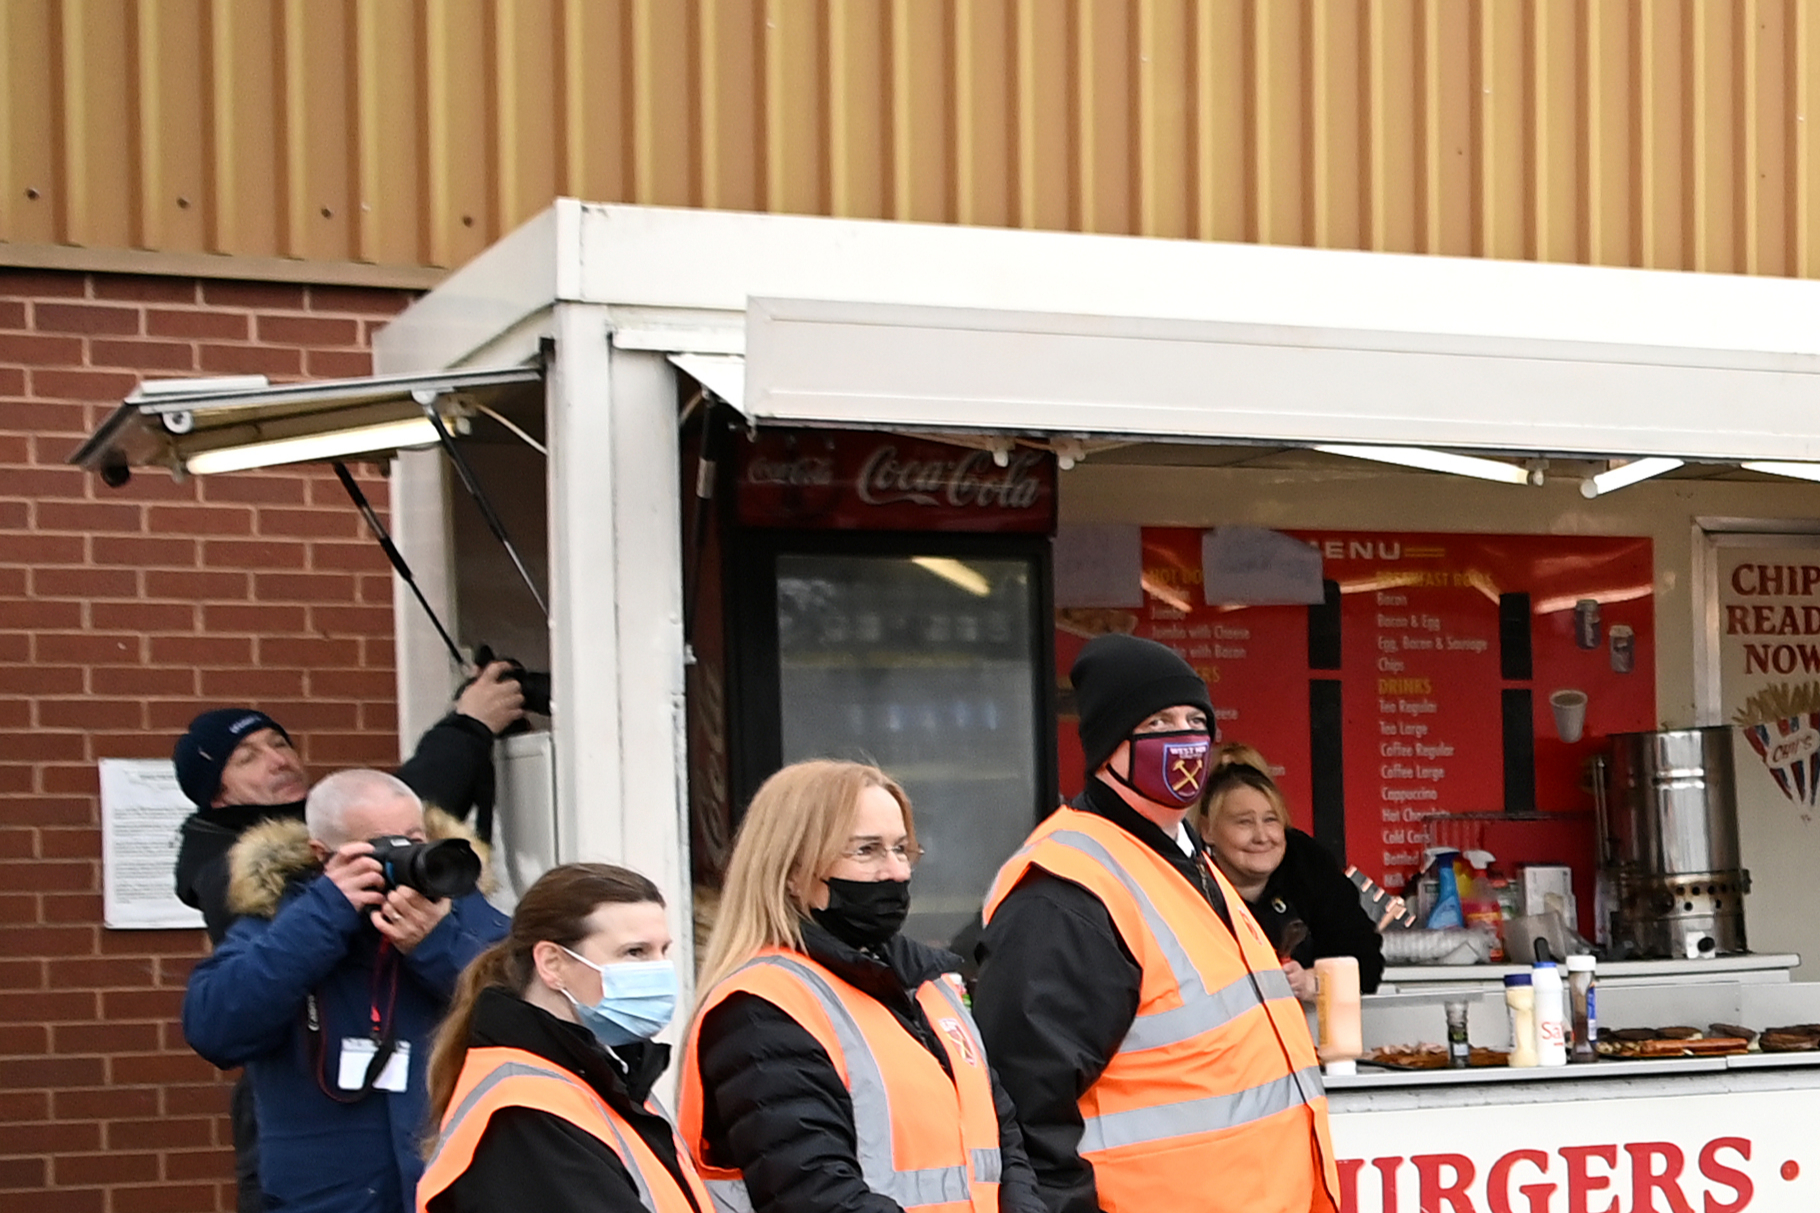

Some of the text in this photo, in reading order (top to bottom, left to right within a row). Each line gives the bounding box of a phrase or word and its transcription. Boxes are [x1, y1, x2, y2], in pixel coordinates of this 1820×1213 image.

[855, 445, 1045, 507] Coca-Cola
[1310, 541, 1400, 560] ENU
[1381, 741, 1454, 760] Coffee Regular
[1381, 763, 1445, 782] Coffee Large
[1382, 787, 1438, 803] Cappuccino
